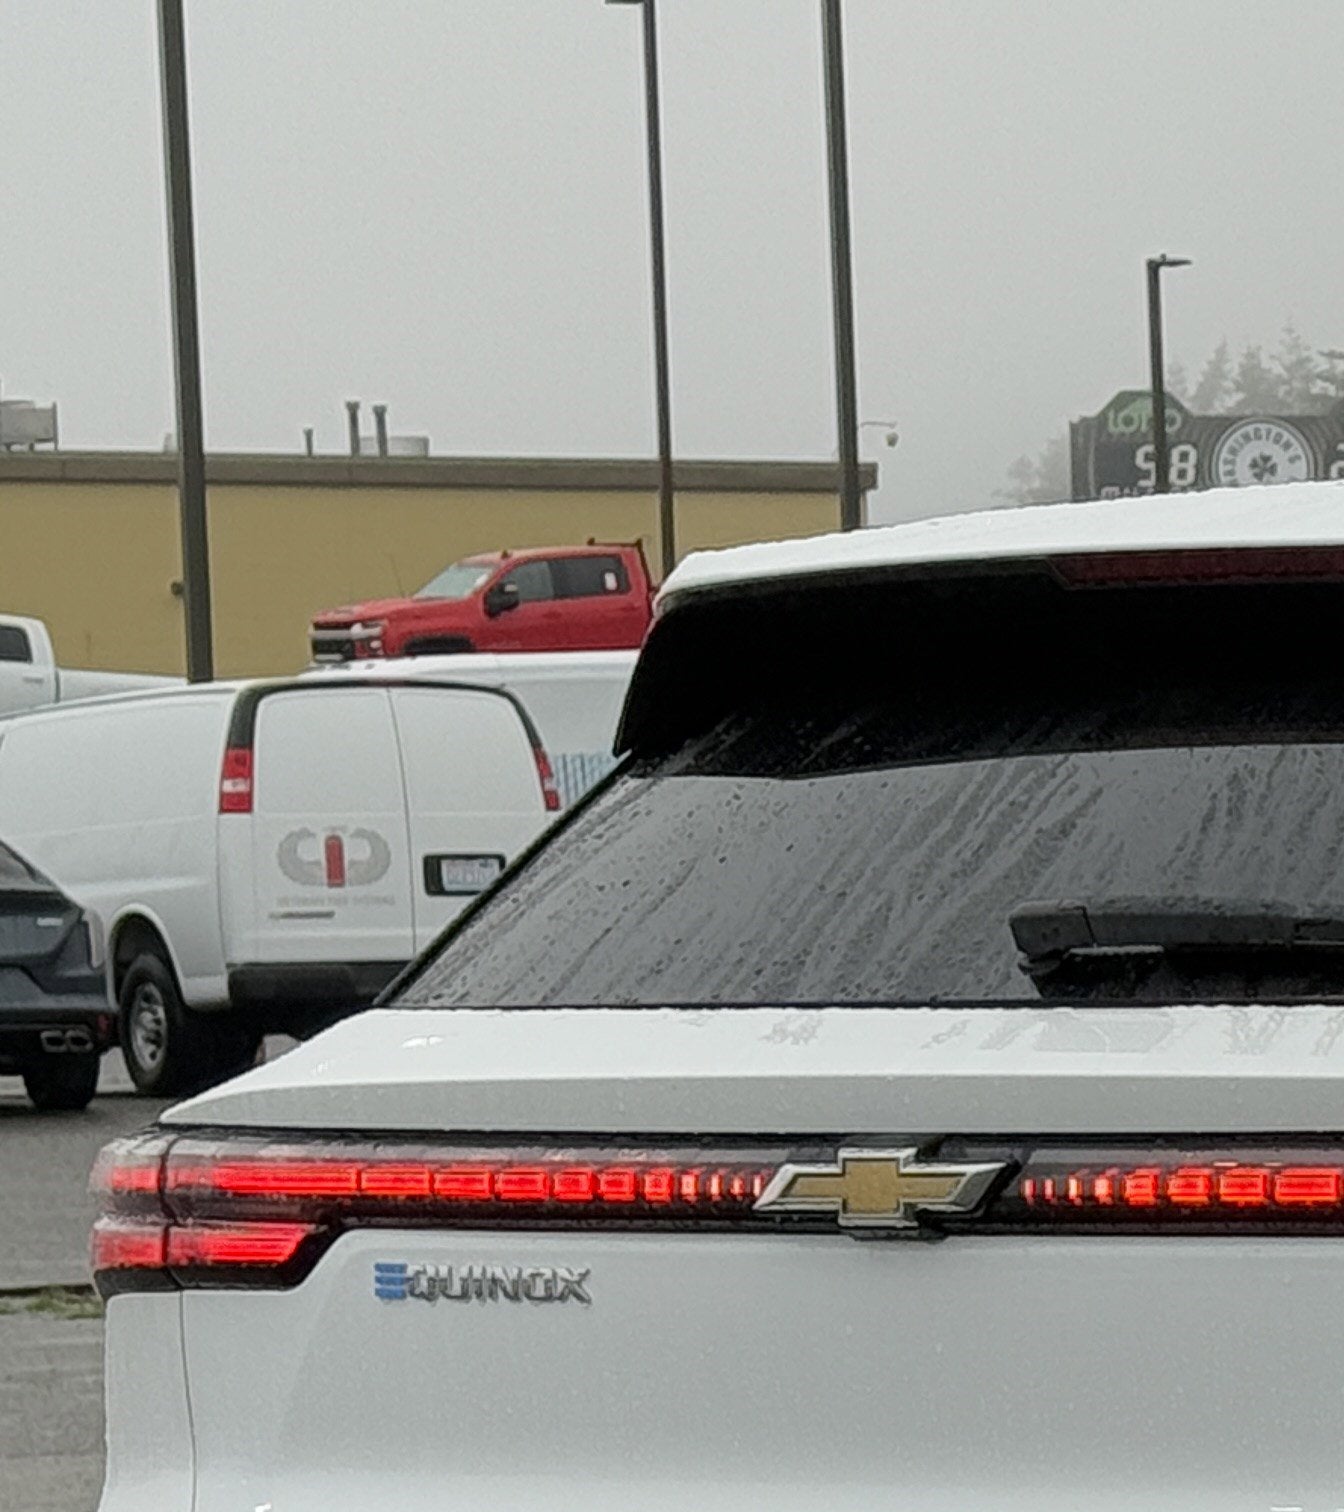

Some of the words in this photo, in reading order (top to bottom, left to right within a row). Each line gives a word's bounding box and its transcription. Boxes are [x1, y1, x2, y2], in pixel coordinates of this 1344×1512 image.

[1108, 405, 1183, 434] LOTO
[1220, 425, 1305, 489] ASHINGTON'S
[374, 1261, 594, 1306] EQUINOX
